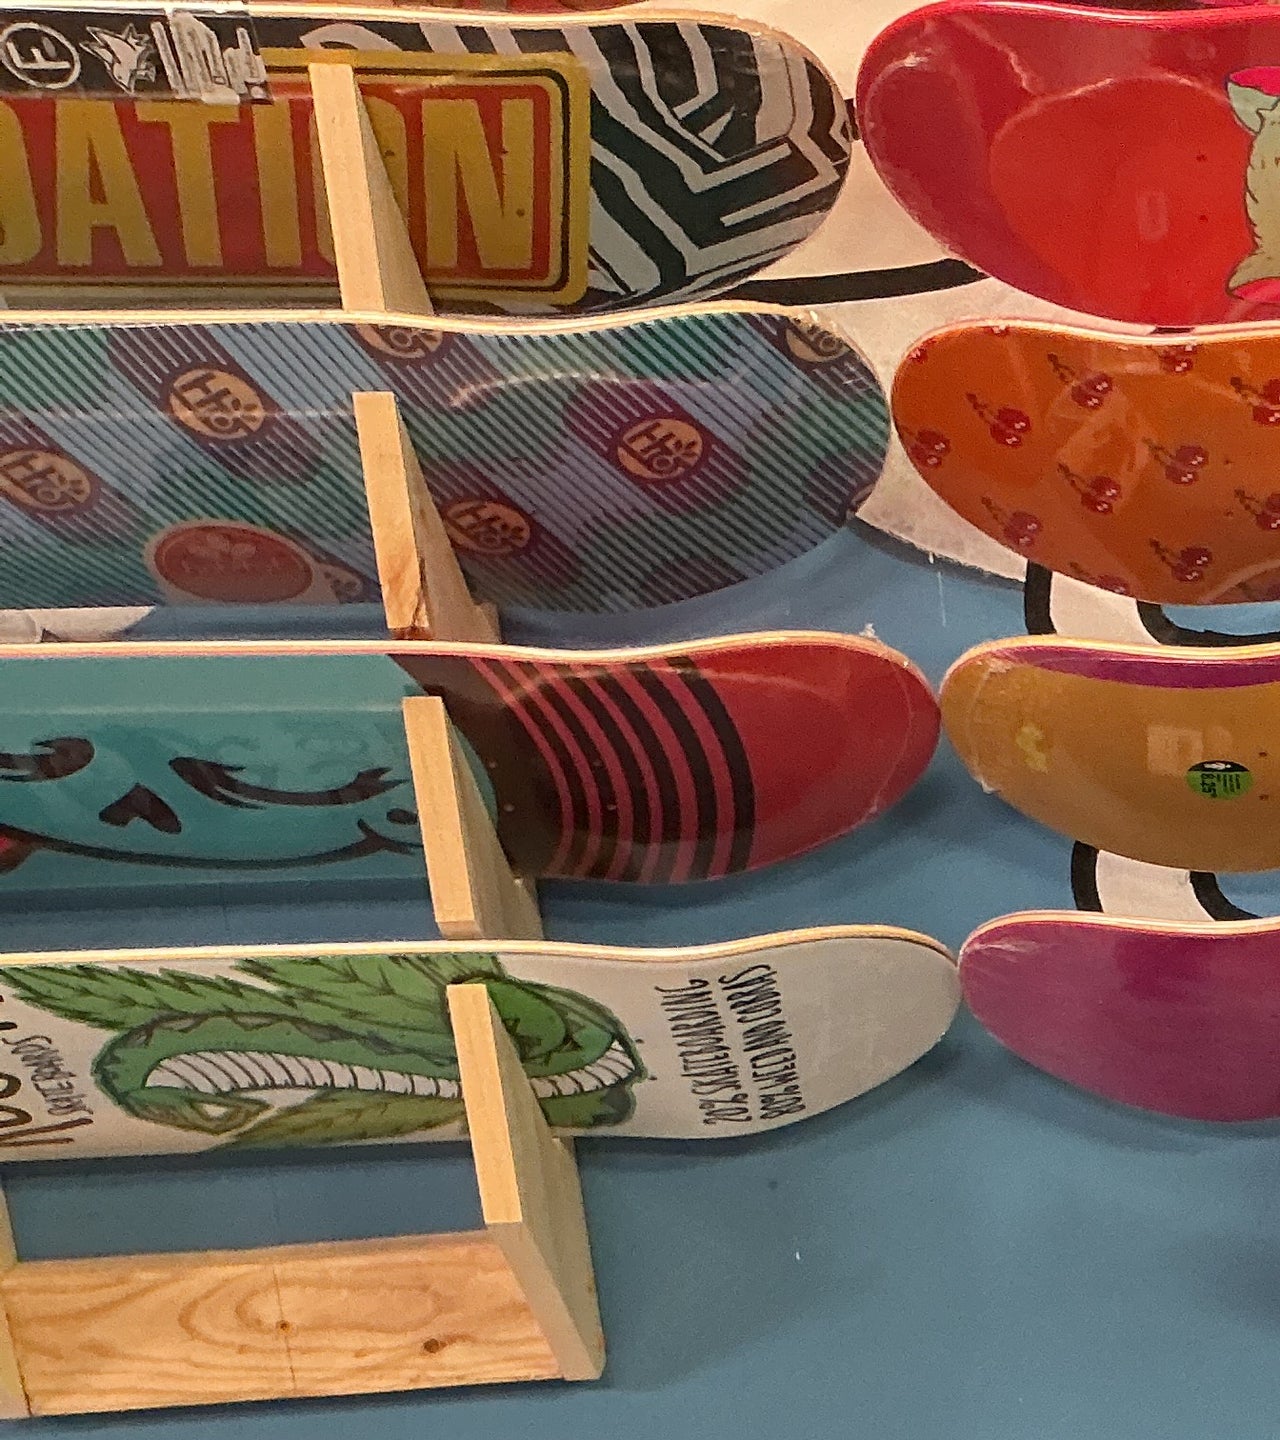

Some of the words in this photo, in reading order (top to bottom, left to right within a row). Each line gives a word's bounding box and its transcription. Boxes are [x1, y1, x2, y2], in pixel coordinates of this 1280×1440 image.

[718, 964, 782, 1023] COBRAS
[654, 979, 742, 1095] SKATEBOARDING
[742, 1020, 792, 1052] AND
[750, 1048, 799, 1090] WEED
[699, 1093, 753, 1125] 20%
[759, 1085, 806, 1119] 80%
